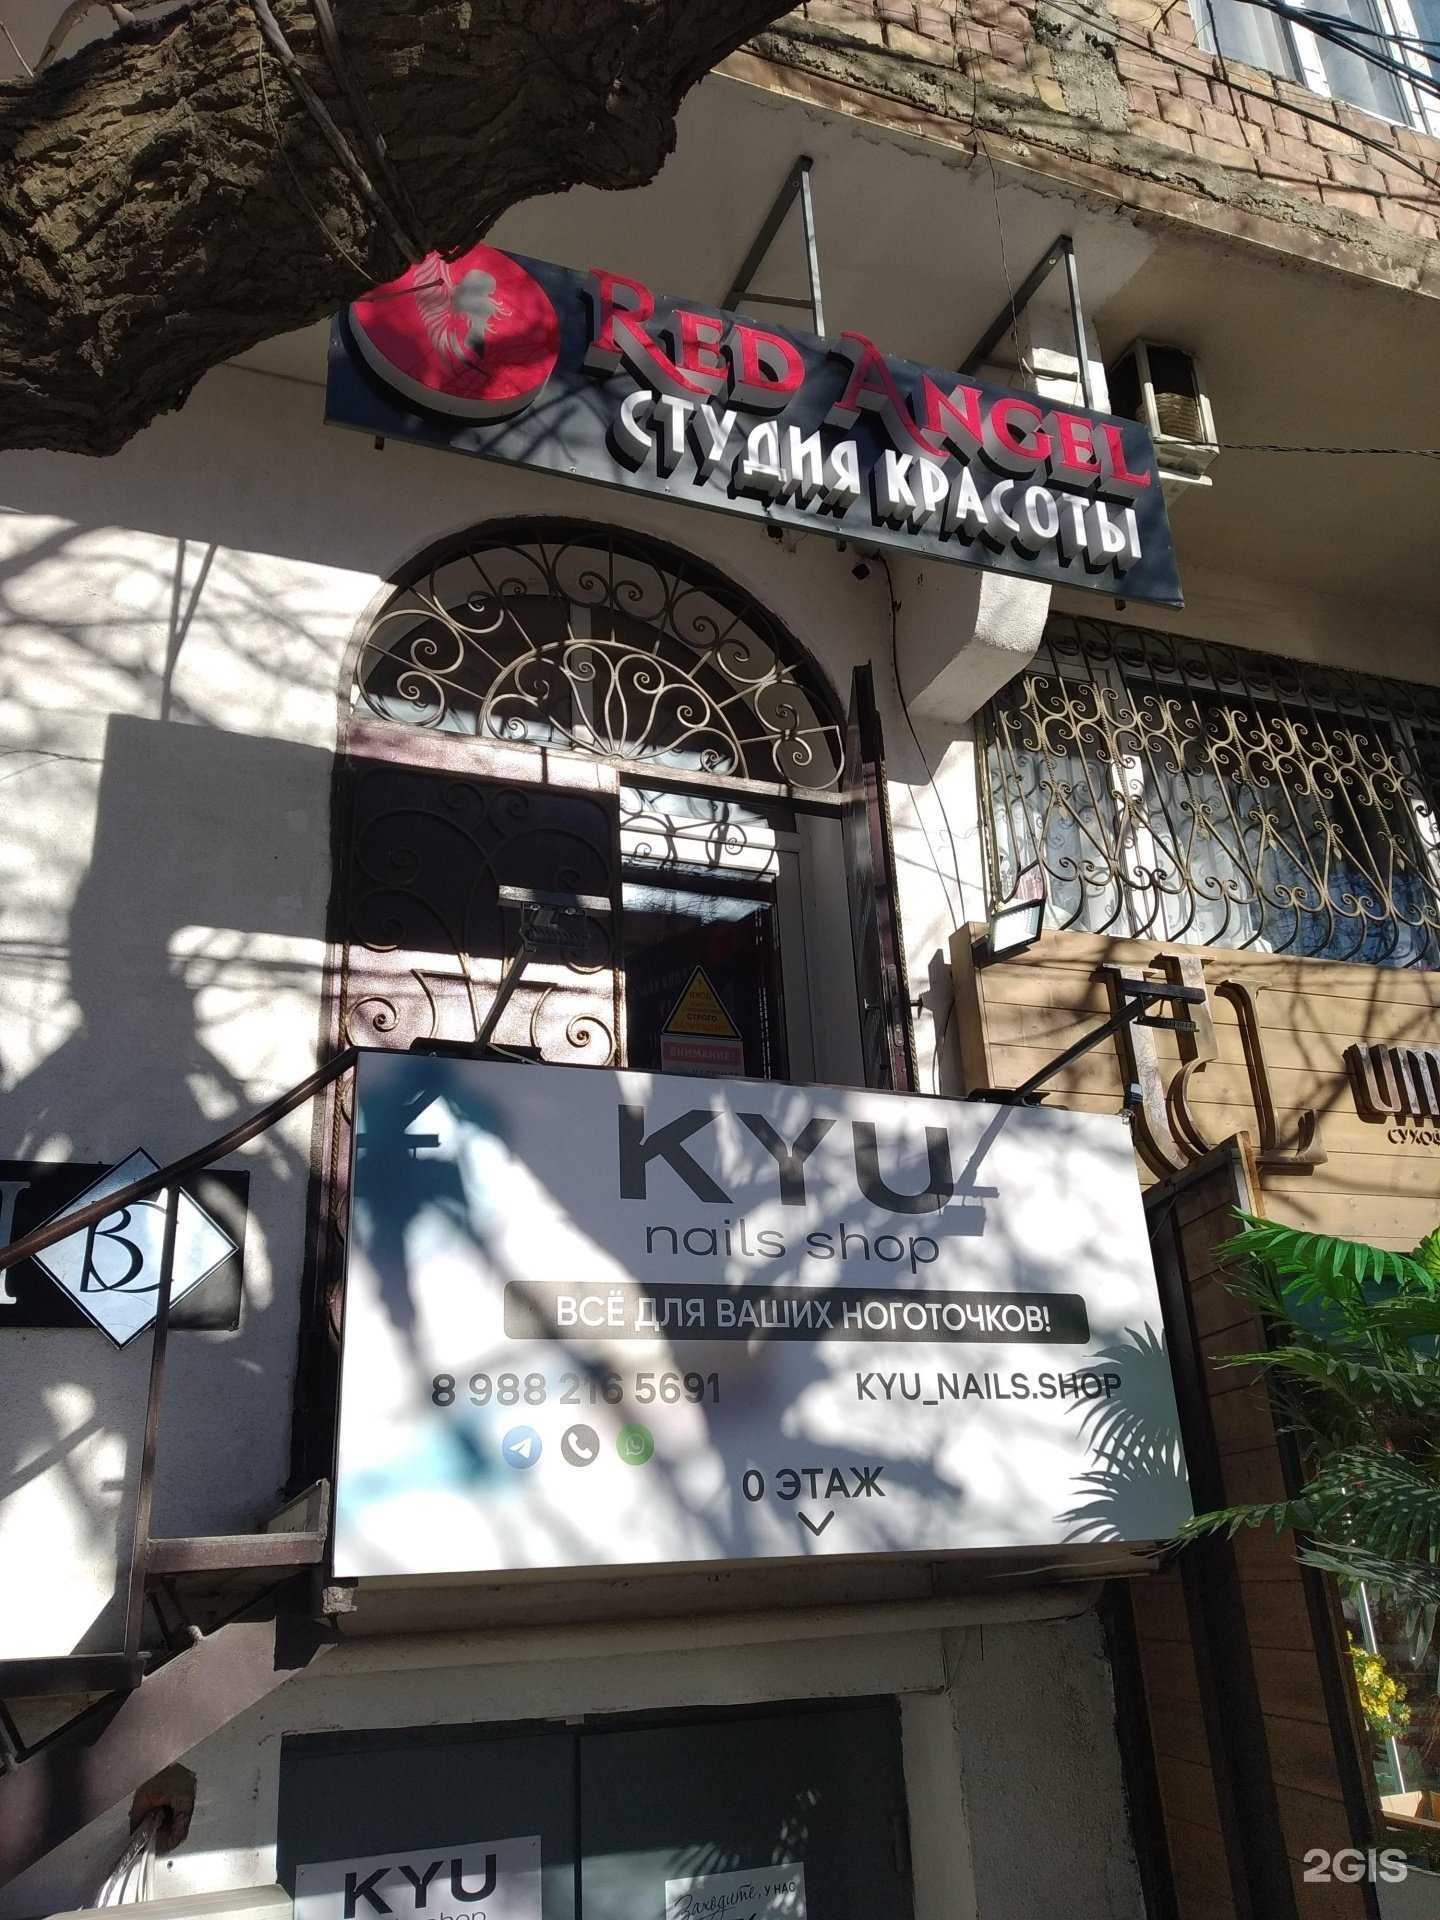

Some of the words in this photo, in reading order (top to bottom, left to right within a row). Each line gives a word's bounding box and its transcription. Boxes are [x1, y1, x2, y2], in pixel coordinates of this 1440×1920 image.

[588, 265, 805, 396] RED
[833, 330, 1151, 488] ANGEL
[620, 390, 861, 495] СТУДИЯ
[885, 449, 1143, 559] КРАСОТЫ
[618, 1104, 955, 1215] KYU
[646, 1218, 787, 1259] nails
[806, 1222, 941, 1275] shop
[556, 1289, 625, 1327] ВСЁ
[634, 1297, 706, 1333] ДЛЯ
[716, 1298, 834, 1330] ВАШИХ
[842, 1300, 1053, 1334] НОГОТОЧКОВ!
[432, 1373, 457, 1408] 8
[468, 1372, 548, 1407] 988
[559, 1372, 625, 1406] 216
[634, 1371, 721, 1406] 5691
[856, 1371, 1123, 1406] KYU_NAILS.SHOP
[776, 1466, 887, 1501] ЭТАЖ
[343, 1853, 497, 1920] KYU
